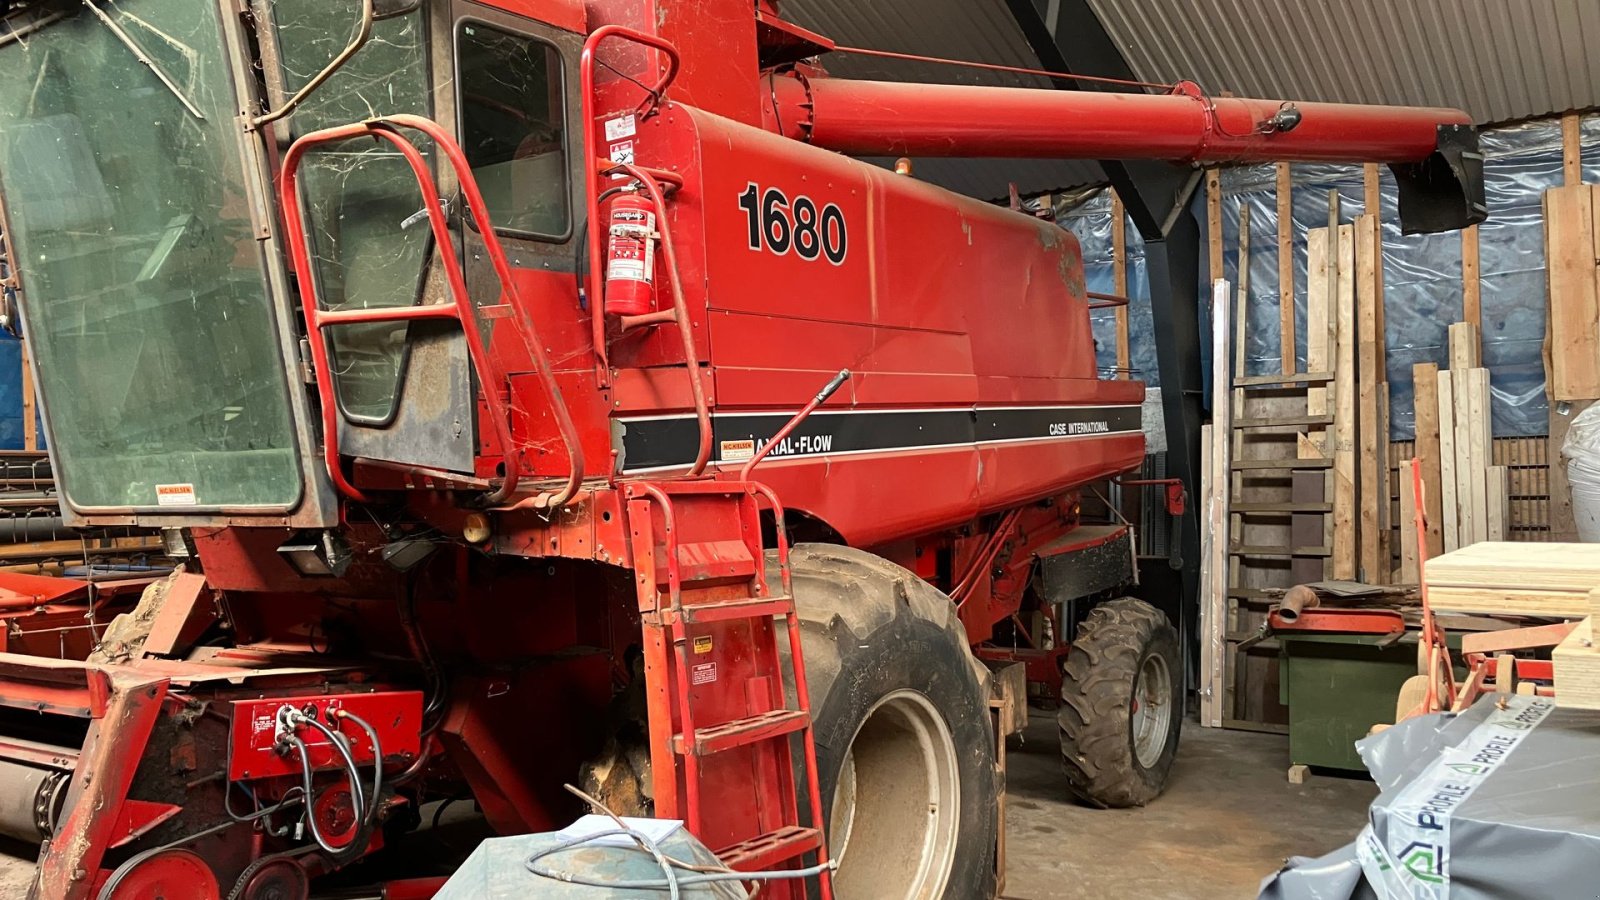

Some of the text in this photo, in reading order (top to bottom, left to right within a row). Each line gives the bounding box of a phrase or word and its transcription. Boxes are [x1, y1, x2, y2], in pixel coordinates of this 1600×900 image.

[738, 181, 847, 266] 1680
[1049, 421, 1109, 436] CASE INTERNATIONAL
[1471, 736, 1518, 765] PROFILE
[1417, 785, 1471, 831] PROFILE
